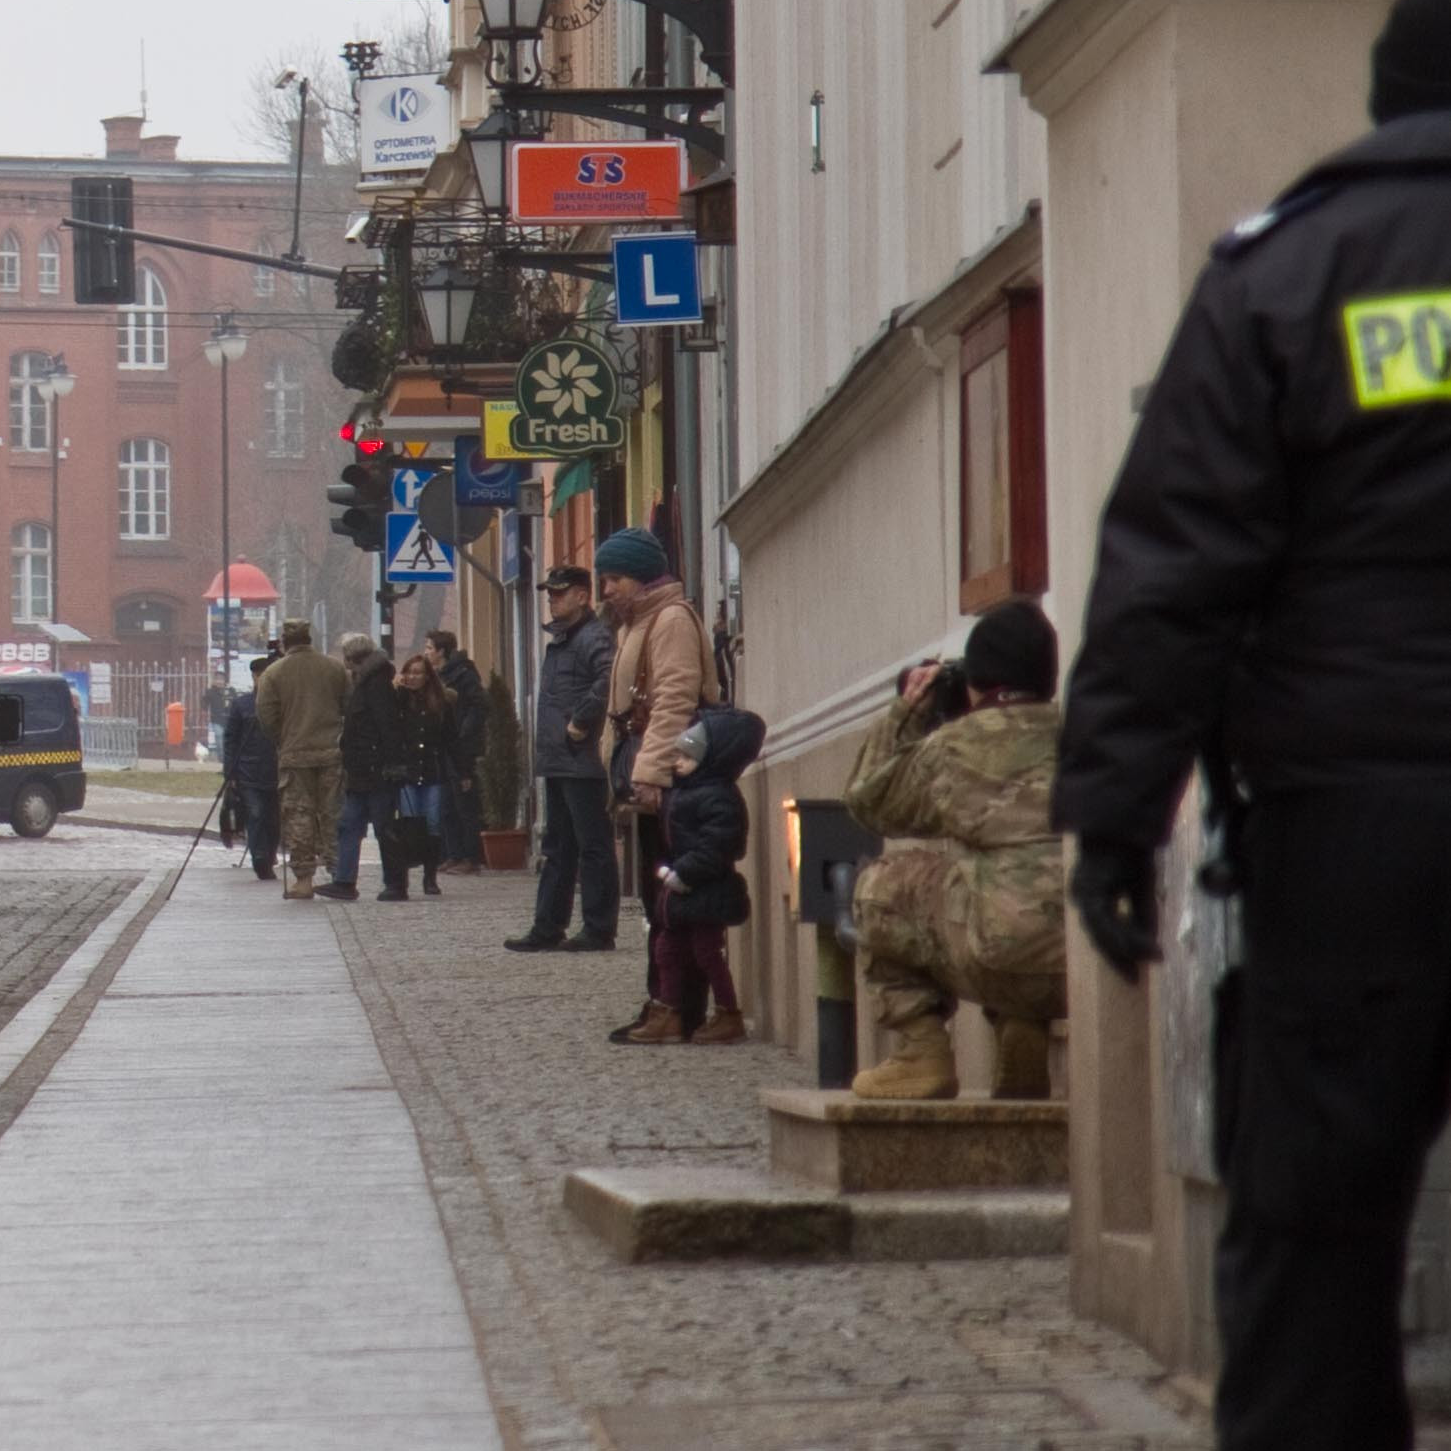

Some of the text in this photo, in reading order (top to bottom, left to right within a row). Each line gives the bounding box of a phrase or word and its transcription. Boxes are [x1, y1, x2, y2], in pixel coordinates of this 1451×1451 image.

[374, 135, 437, 150] OPTOMETRIA
[375, 147, 437, 164] Karczewski
[576, 153, 626, 187] STS
[643, 253, 680, 306] L
[529, 418, 608, 443] Fresh
[468, 486, 512, 503] pepsi
